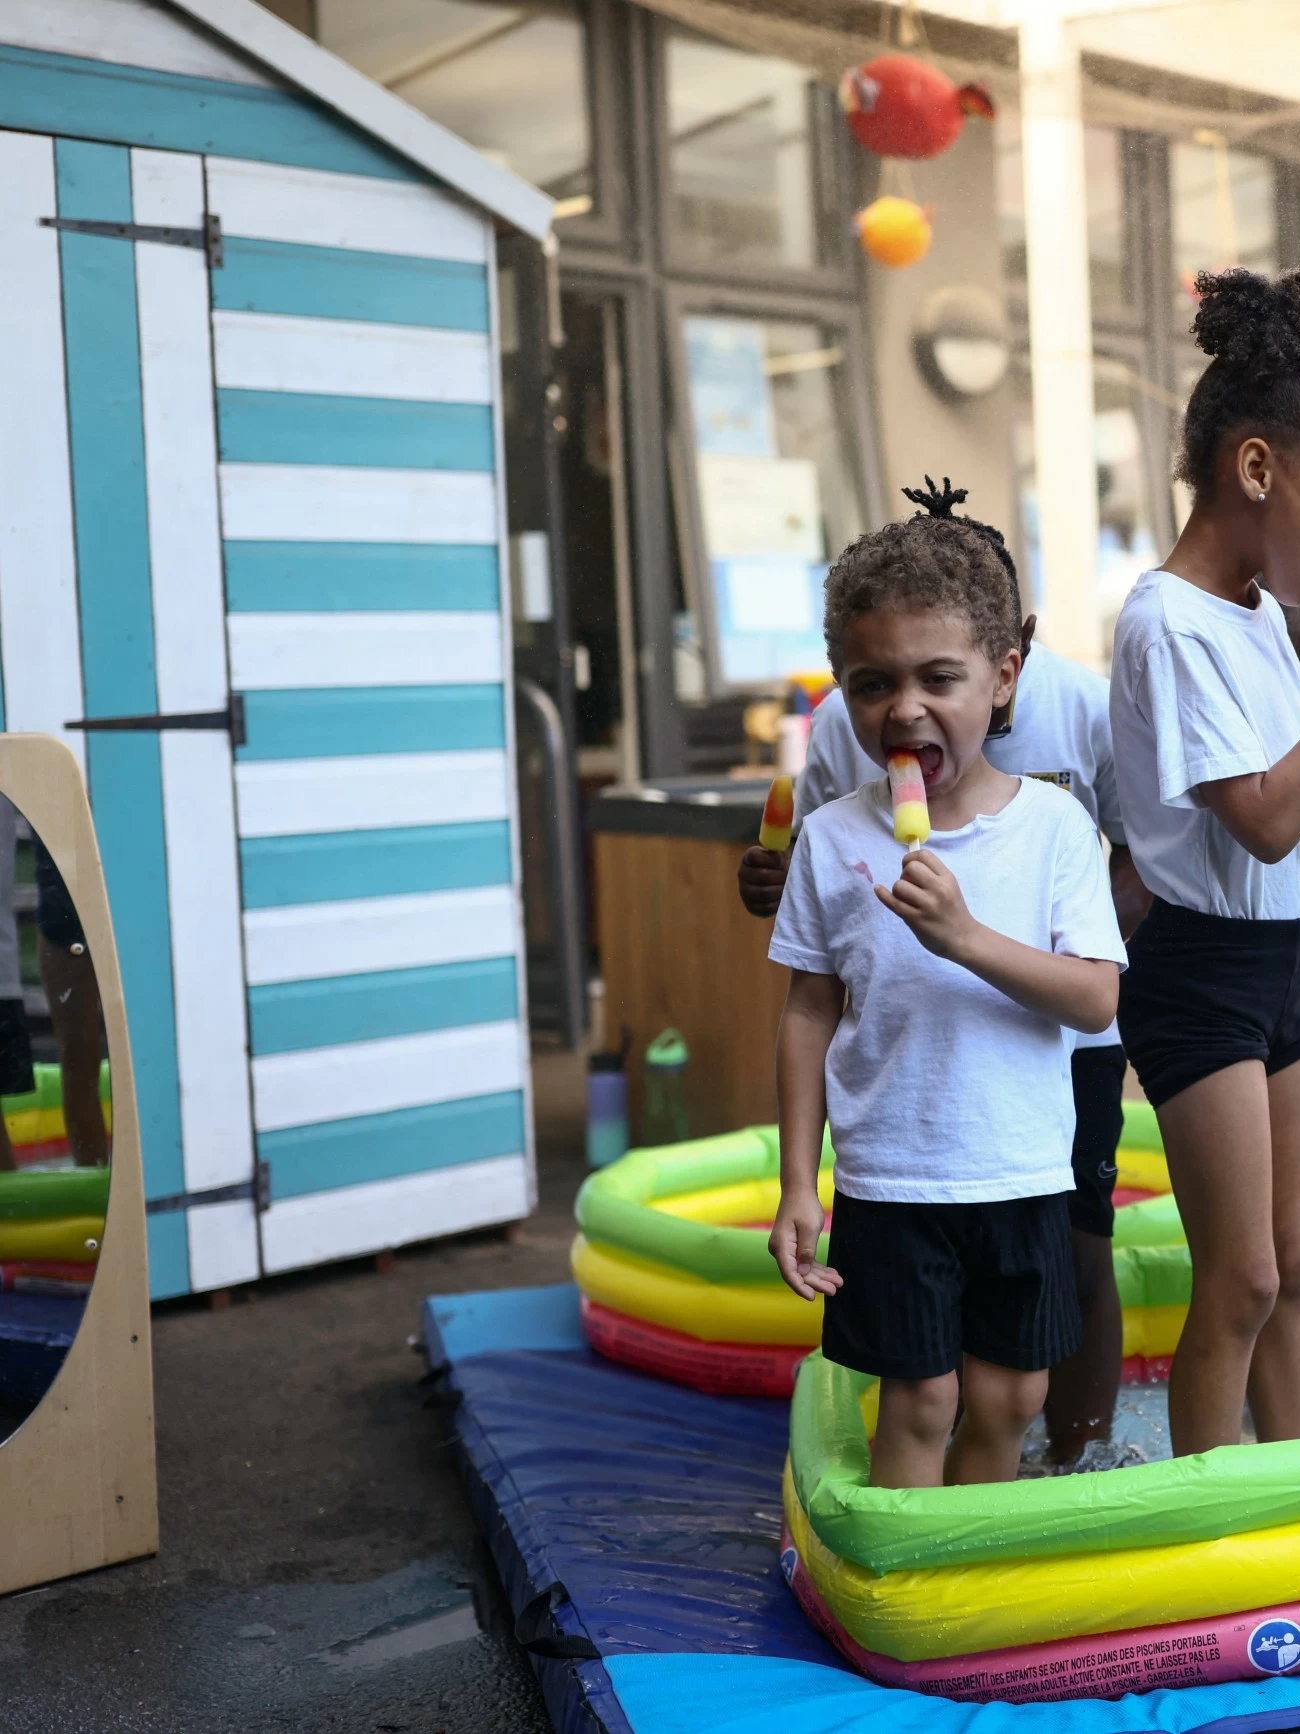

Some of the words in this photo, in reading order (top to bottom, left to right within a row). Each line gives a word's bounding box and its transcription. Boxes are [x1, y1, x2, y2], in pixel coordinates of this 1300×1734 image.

[920, 1672, 990, 1694] AVERTISSEMENT!
[990, 1673, 1004, 1686] DES
[1006, 1666, 1037, 1684] ENFANTS
[1039, 1664, 1048, 1676] SE
[1050, 1660, 1069, 1674] SONT
[1071, 1653, 1095, 1670] NOYÉS
[1098, 1650, 1118, 1664] DANS
[1120, 1647, 1134, 1660] DES
[1137, 1640, 1170, 1657] PISCINES
[1172, 1633, 1219, 1650] PORTABLES.
[994, 1682, 1039, 1699] SUPERVISION
[1041, 1676, 1068, 1691] ADULTE
[1069, 1670, 1095, 1686] ACTIVE
[1096, 1661, 1142, 1680] CONSTANTE.
[1144, 1659, 1155, 1671] NE
[1156, 1654, 1187, 1668] LAISSEZ
[1189, 1652, 1204, 1663] PAS
[1206, 1648, 1220, 1661] LES
[1059, 1686, 1087, 1700] AUTOUR
[1090, 1685, 1101, 1695] DE
[1101, 1682, 1111, 1694] LA
[1112, 1677, 1142, 1692] PISCINE
[1147, 1666, 1195, 1683] GARDEZ-LES
[1196, 1664, 1202, 1675] À
